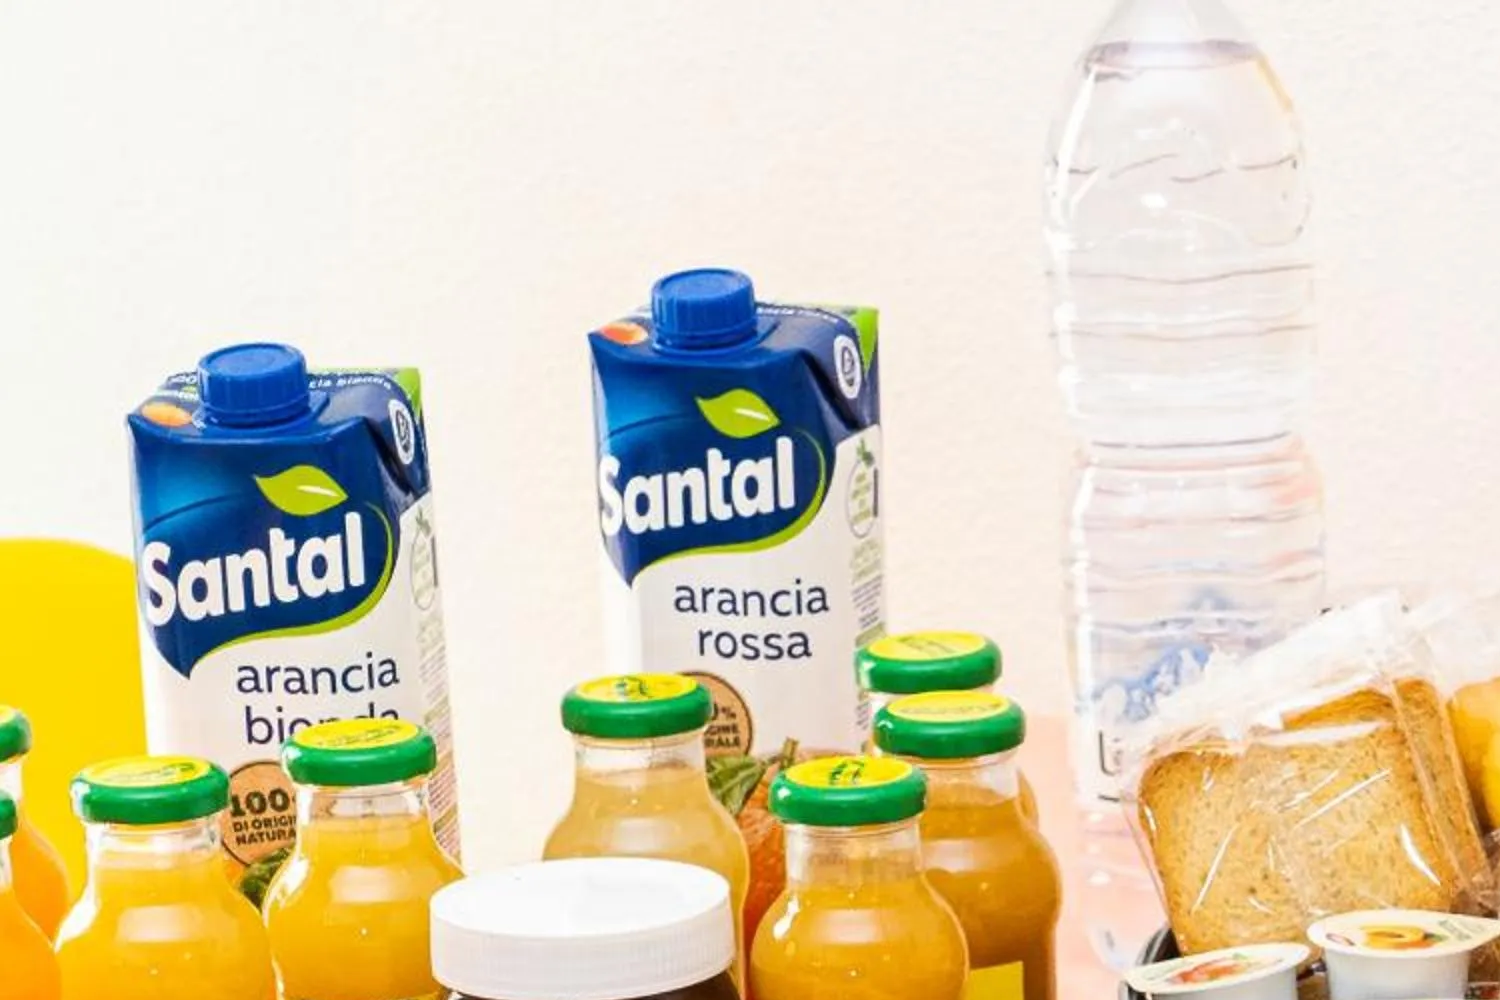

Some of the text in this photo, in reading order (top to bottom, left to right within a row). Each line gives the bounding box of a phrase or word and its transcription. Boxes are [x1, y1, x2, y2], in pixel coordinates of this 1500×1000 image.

[600, 435, 795, 536] Santal
[141, 511, 365, 627] Santal
[673, 578, 830, 617] arancia
[698, 628, 812, 661] rossa
[235, 651, 401, 696] arancia
[231, 787, 296, 818] 100
[233, 815, 297, 833] DI ORIGI
[235, 828, 297, 846] NATURA
